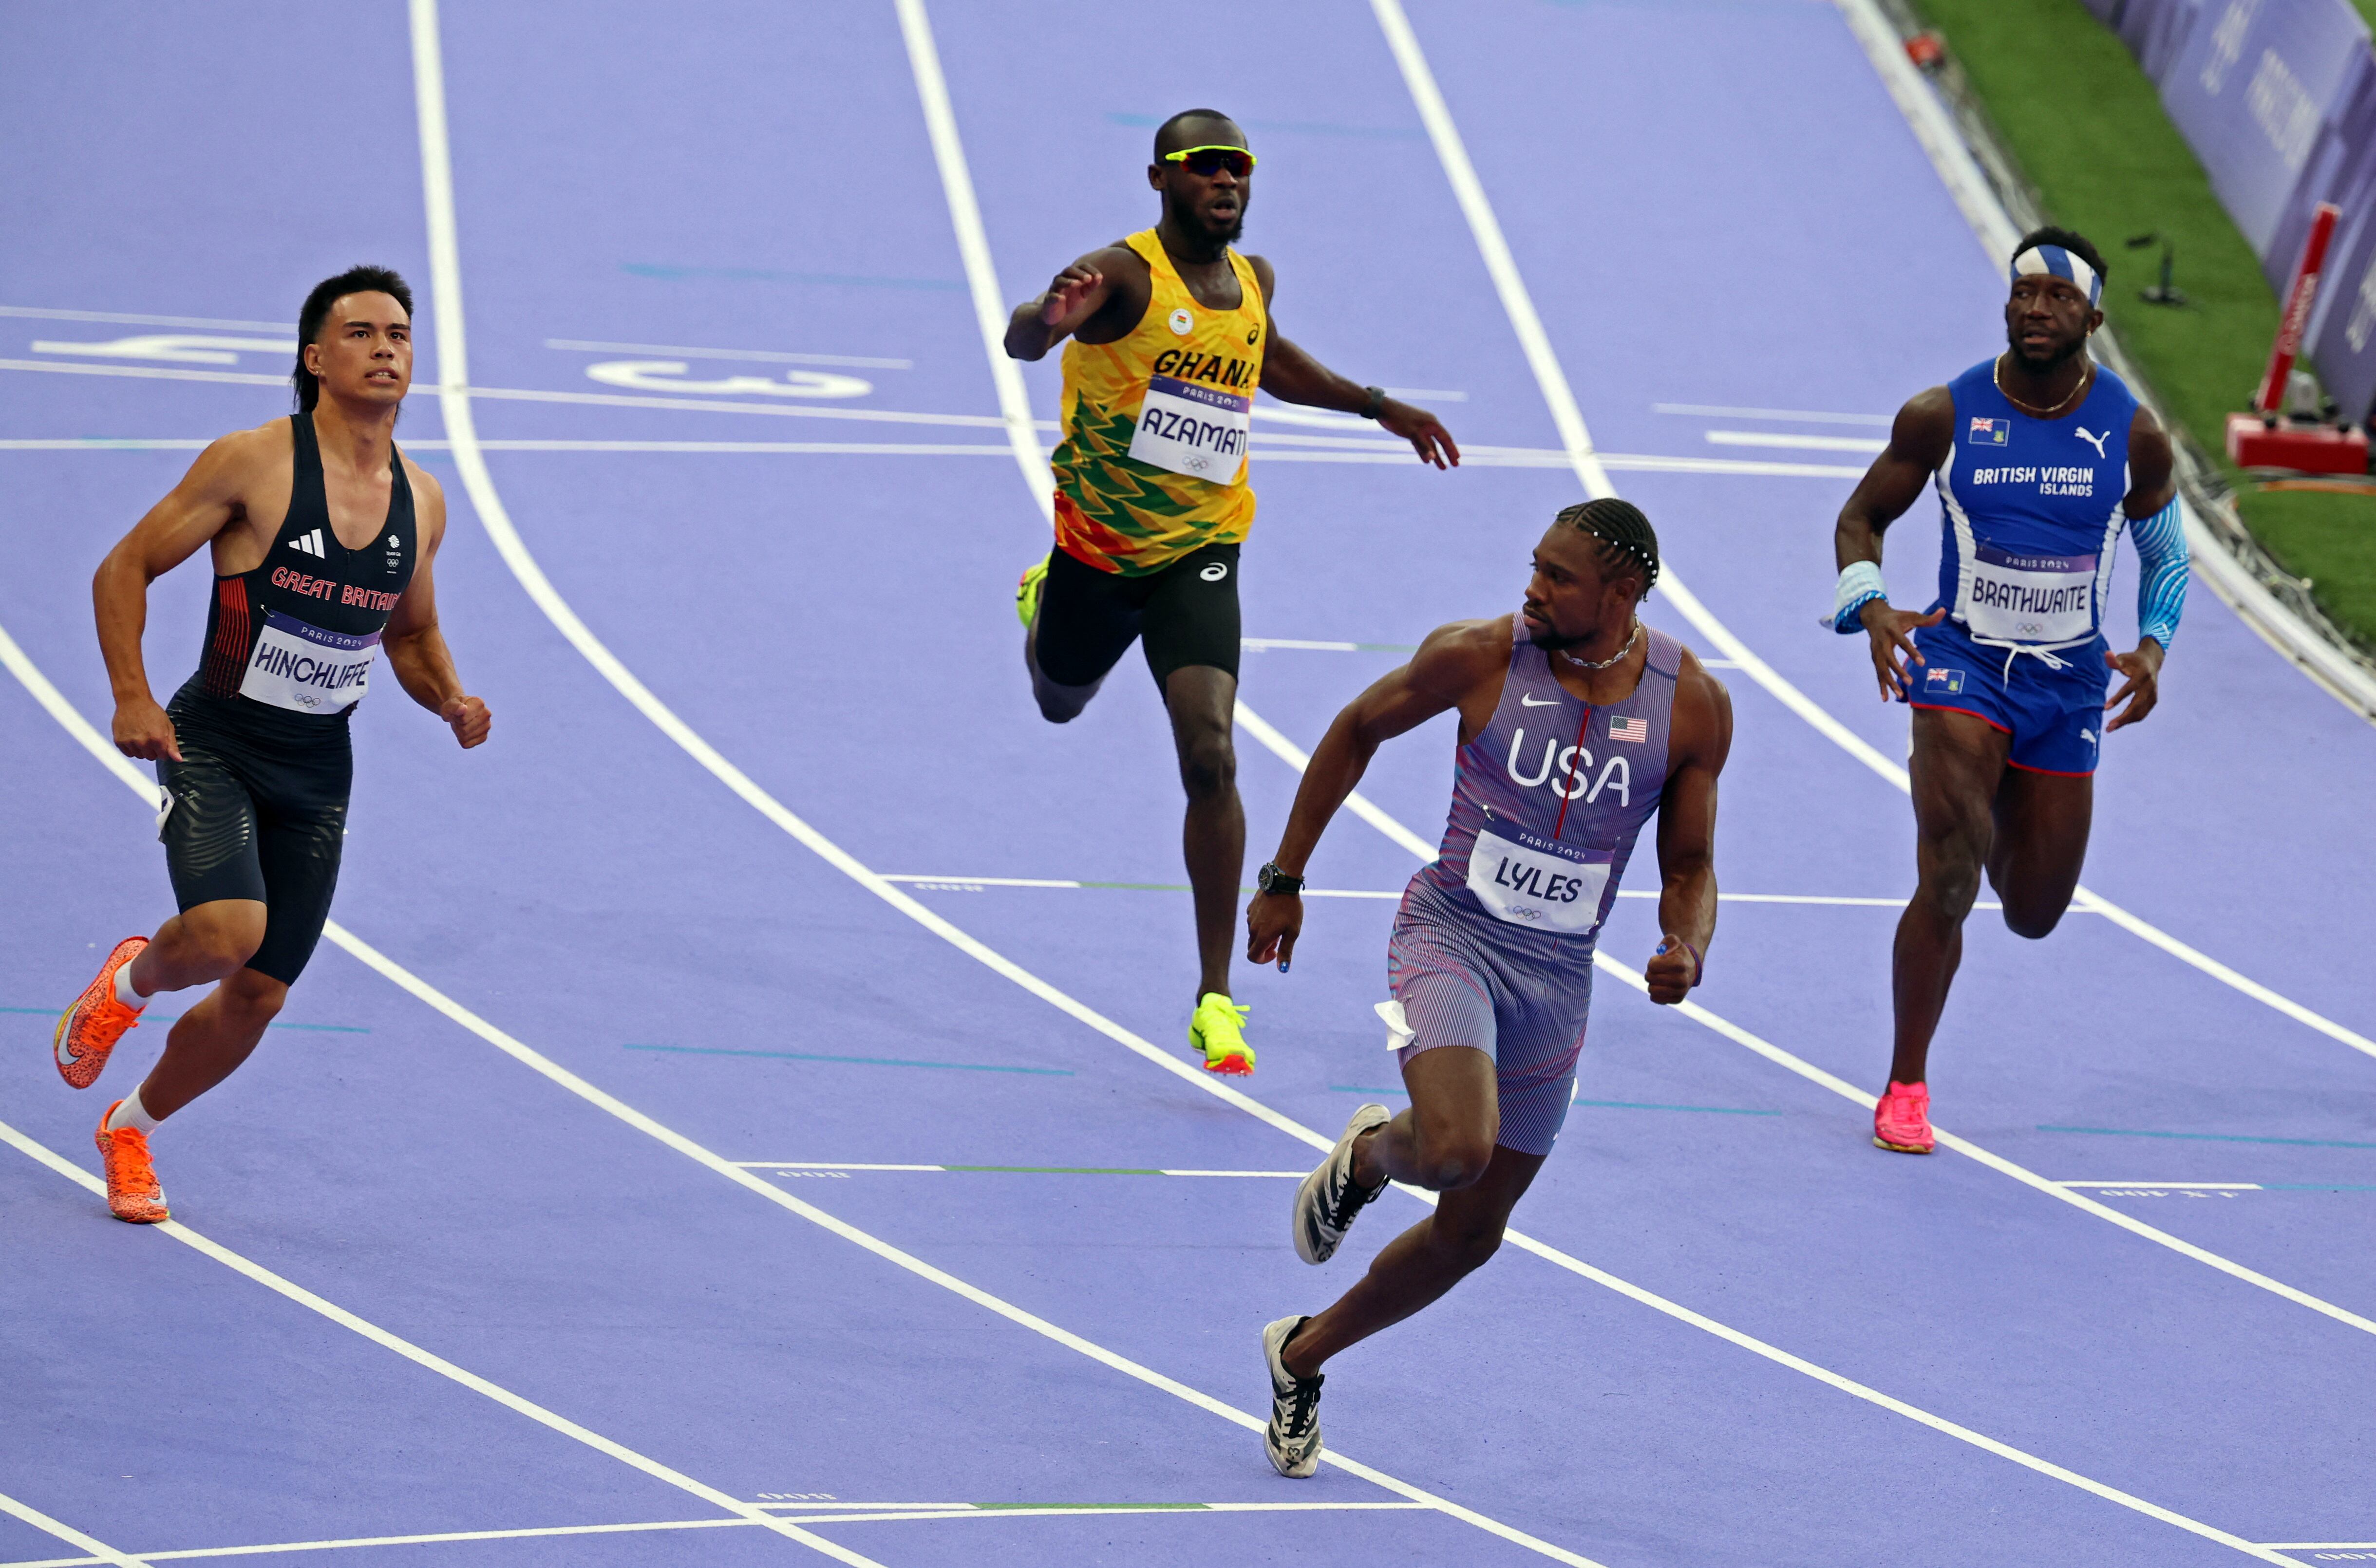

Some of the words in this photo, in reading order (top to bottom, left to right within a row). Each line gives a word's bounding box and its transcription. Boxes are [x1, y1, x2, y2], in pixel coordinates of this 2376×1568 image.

[585, 359, 874, 399] 3
[1183, 386, 1214, 402] PARIS
[1973, 467, 2037, 485] BRITISH
[2040, 467, 2093, 484] VIRGIN
[2039, 483, 2093, 497] ISLANDS
[2005, 556, 2038, 568] PARIS
[271, 566, 337, 600] GREAT
[341, 584, 401, 611] BRITAIN
[1973, 576, 2088, 615] BRATHWAITE
[301, 626, 333, 643] PARIS
[336, 637, 362, 647] 2024
[255, 642, 370, 690] HINCHLIFFE
[1507, 728, 1630, 808] USA
[1519, 833, 1553, 851] PARIS
[1557, 846, 1586, 860] 2024
[1494, 856, 1583, 903] LYLES
[1285, 1446, 1301, 1471] Y-3
